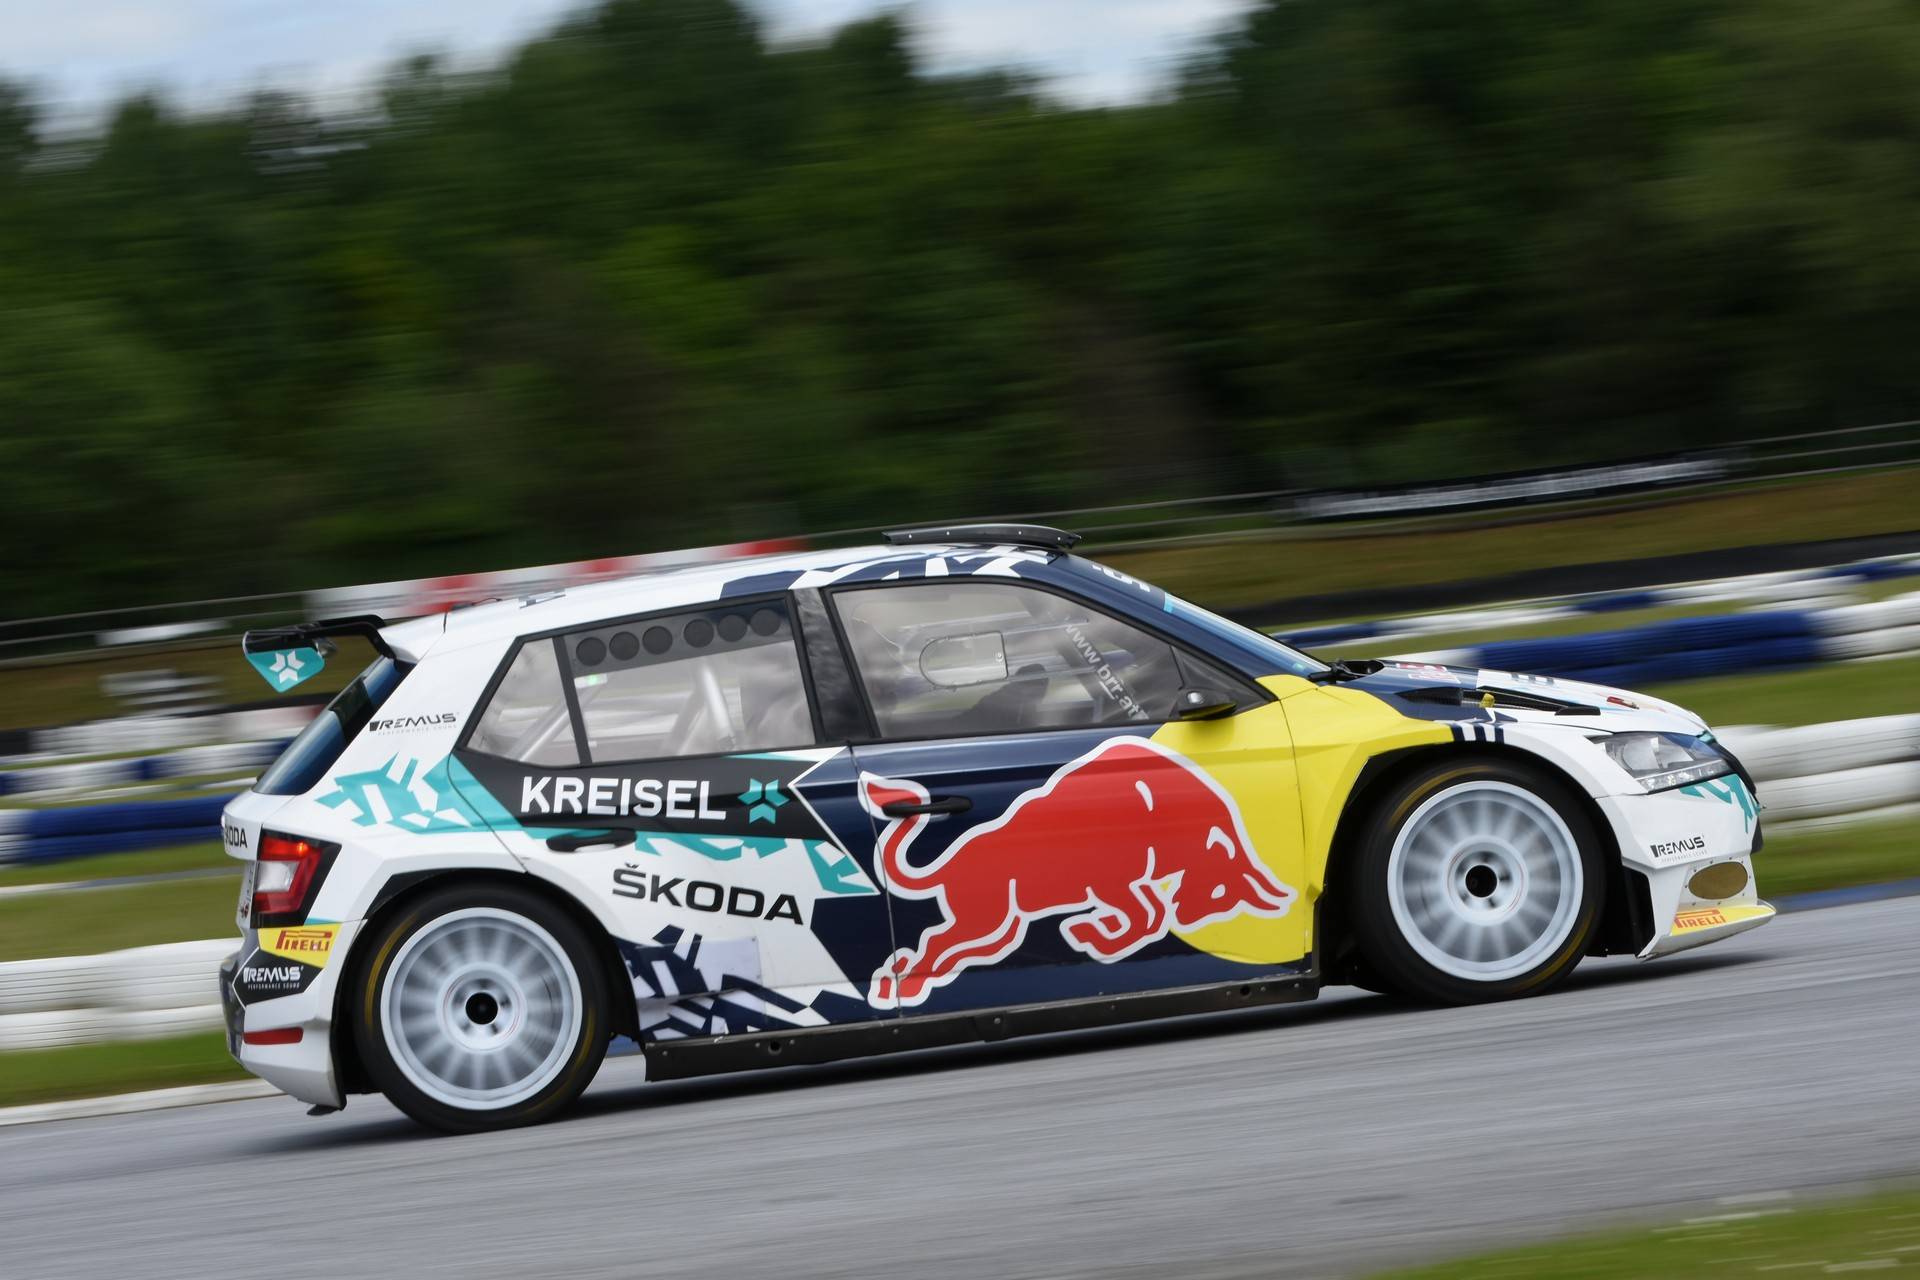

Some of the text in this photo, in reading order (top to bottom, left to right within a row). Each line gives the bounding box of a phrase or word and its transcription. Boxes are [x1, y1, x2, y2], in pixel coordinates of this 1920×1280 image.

[1064, 617, 1140, 717] wwwbrr.at
[379, 713, 456, 730] REMUS
[520, 776, 727, 820] KREISEL
[1657, 836, 1705, 856] REMUS
[612, 862, 804, 925] ŠKODA
[1673, 909, 1727, 928] PIRELLI
[276, 930, 333, 951] PIRELLI
[248, 966, 301, 982] REMUS
